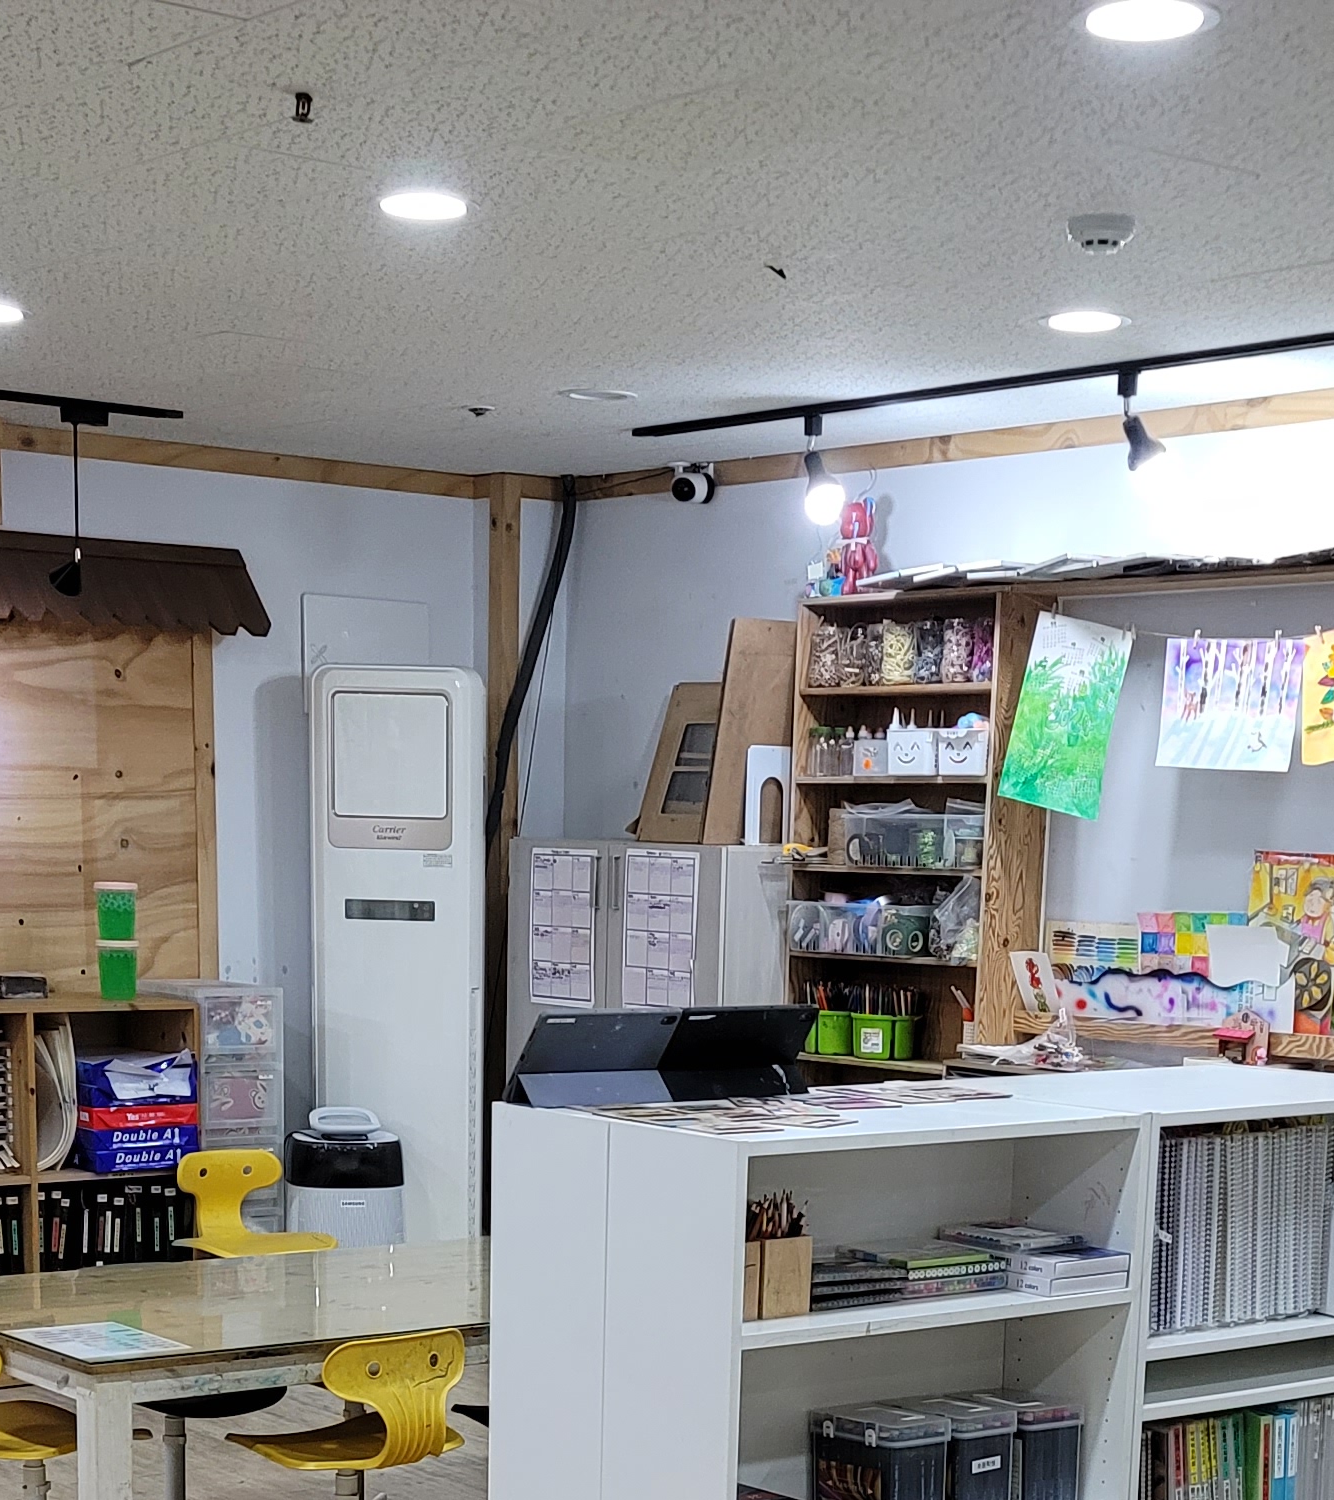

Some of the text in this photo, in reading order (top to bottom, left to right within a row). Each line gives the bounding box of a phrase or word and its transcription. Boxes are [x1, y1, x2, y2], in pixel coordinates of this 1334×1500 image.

[372, 825, 406, 834] Carrier
[126, 1112, 140, 1121] Yes
[112, 1128, 172, 1143] Double A
[115, 1149, 174, 1164] Double A
[1020, 1261, 1043, 1273] 12 colors
[1016, 1279, 1039, 1291] 12 colors
